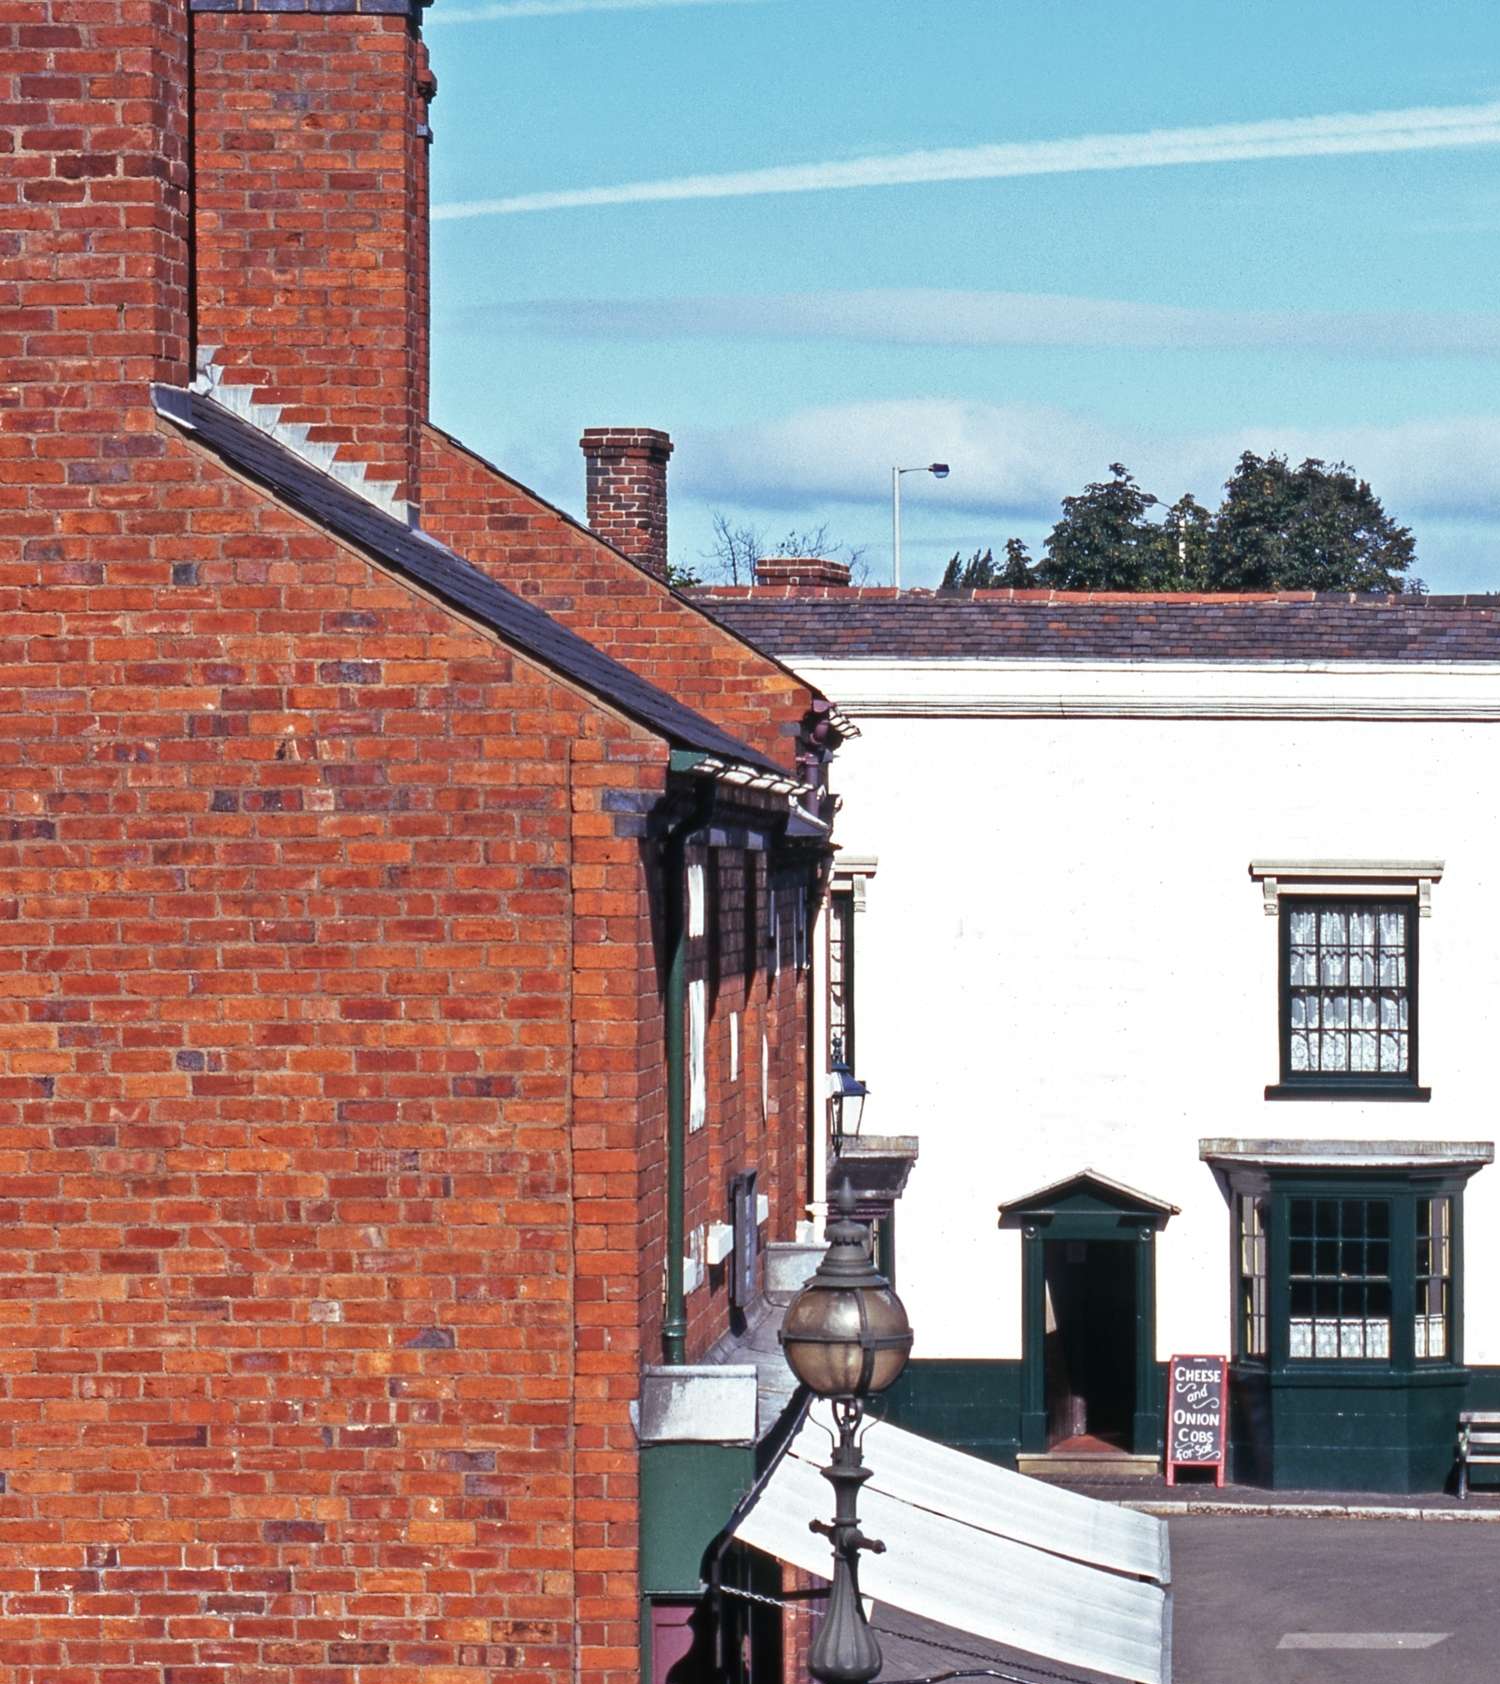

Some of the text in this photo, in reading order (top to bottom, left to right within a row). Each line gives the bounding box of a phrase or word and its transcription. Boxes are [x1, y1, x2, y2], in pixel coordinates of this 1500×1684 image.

[1175, 1366, 1221, 1383] CHEESE
[1187, 1384, 1208, 1402] and
[1174, 1409, 1220, 1426] ONION
[1178, 1428, 1214, 1443] COBS
